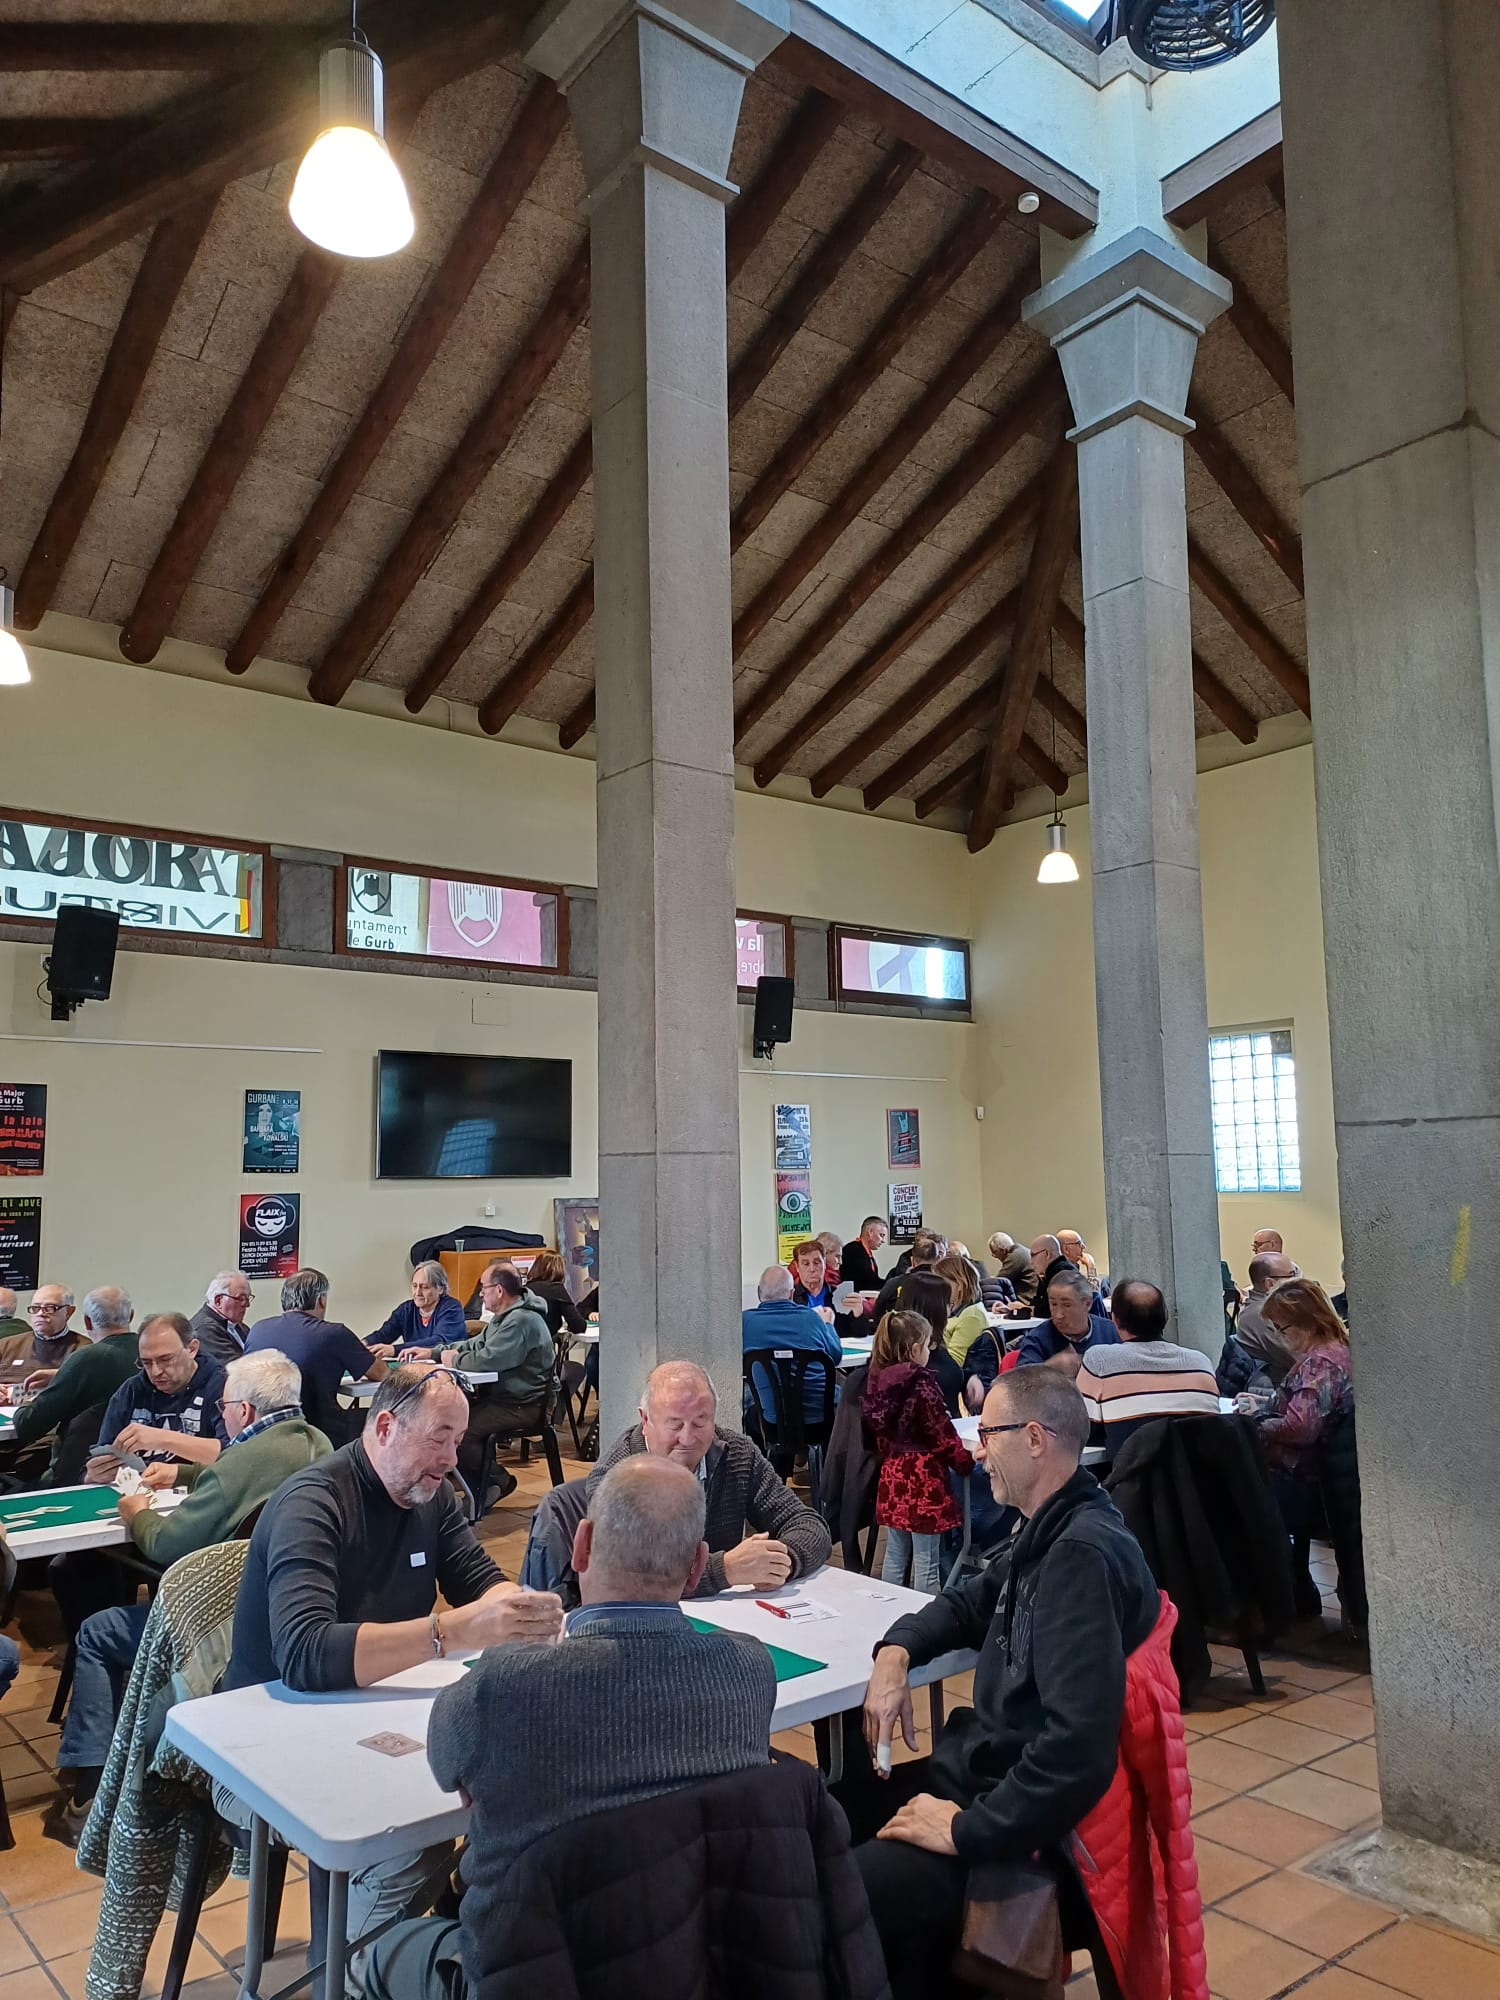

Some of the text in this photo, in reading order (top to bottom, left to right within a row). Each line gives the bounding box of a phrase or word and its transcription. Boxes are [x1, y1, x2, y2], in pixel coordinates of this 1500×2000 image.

[365, 935, 394, 950] Gurb
[3, 1089, 25, 1098] Major
[247, 1093, 276, 1104] GURBAN
[893, 1185, 918, 1195] CONCERT
[18, 1198, 41, 1208] JOVE
[256, 1208, 280, 1217] FLAIX
